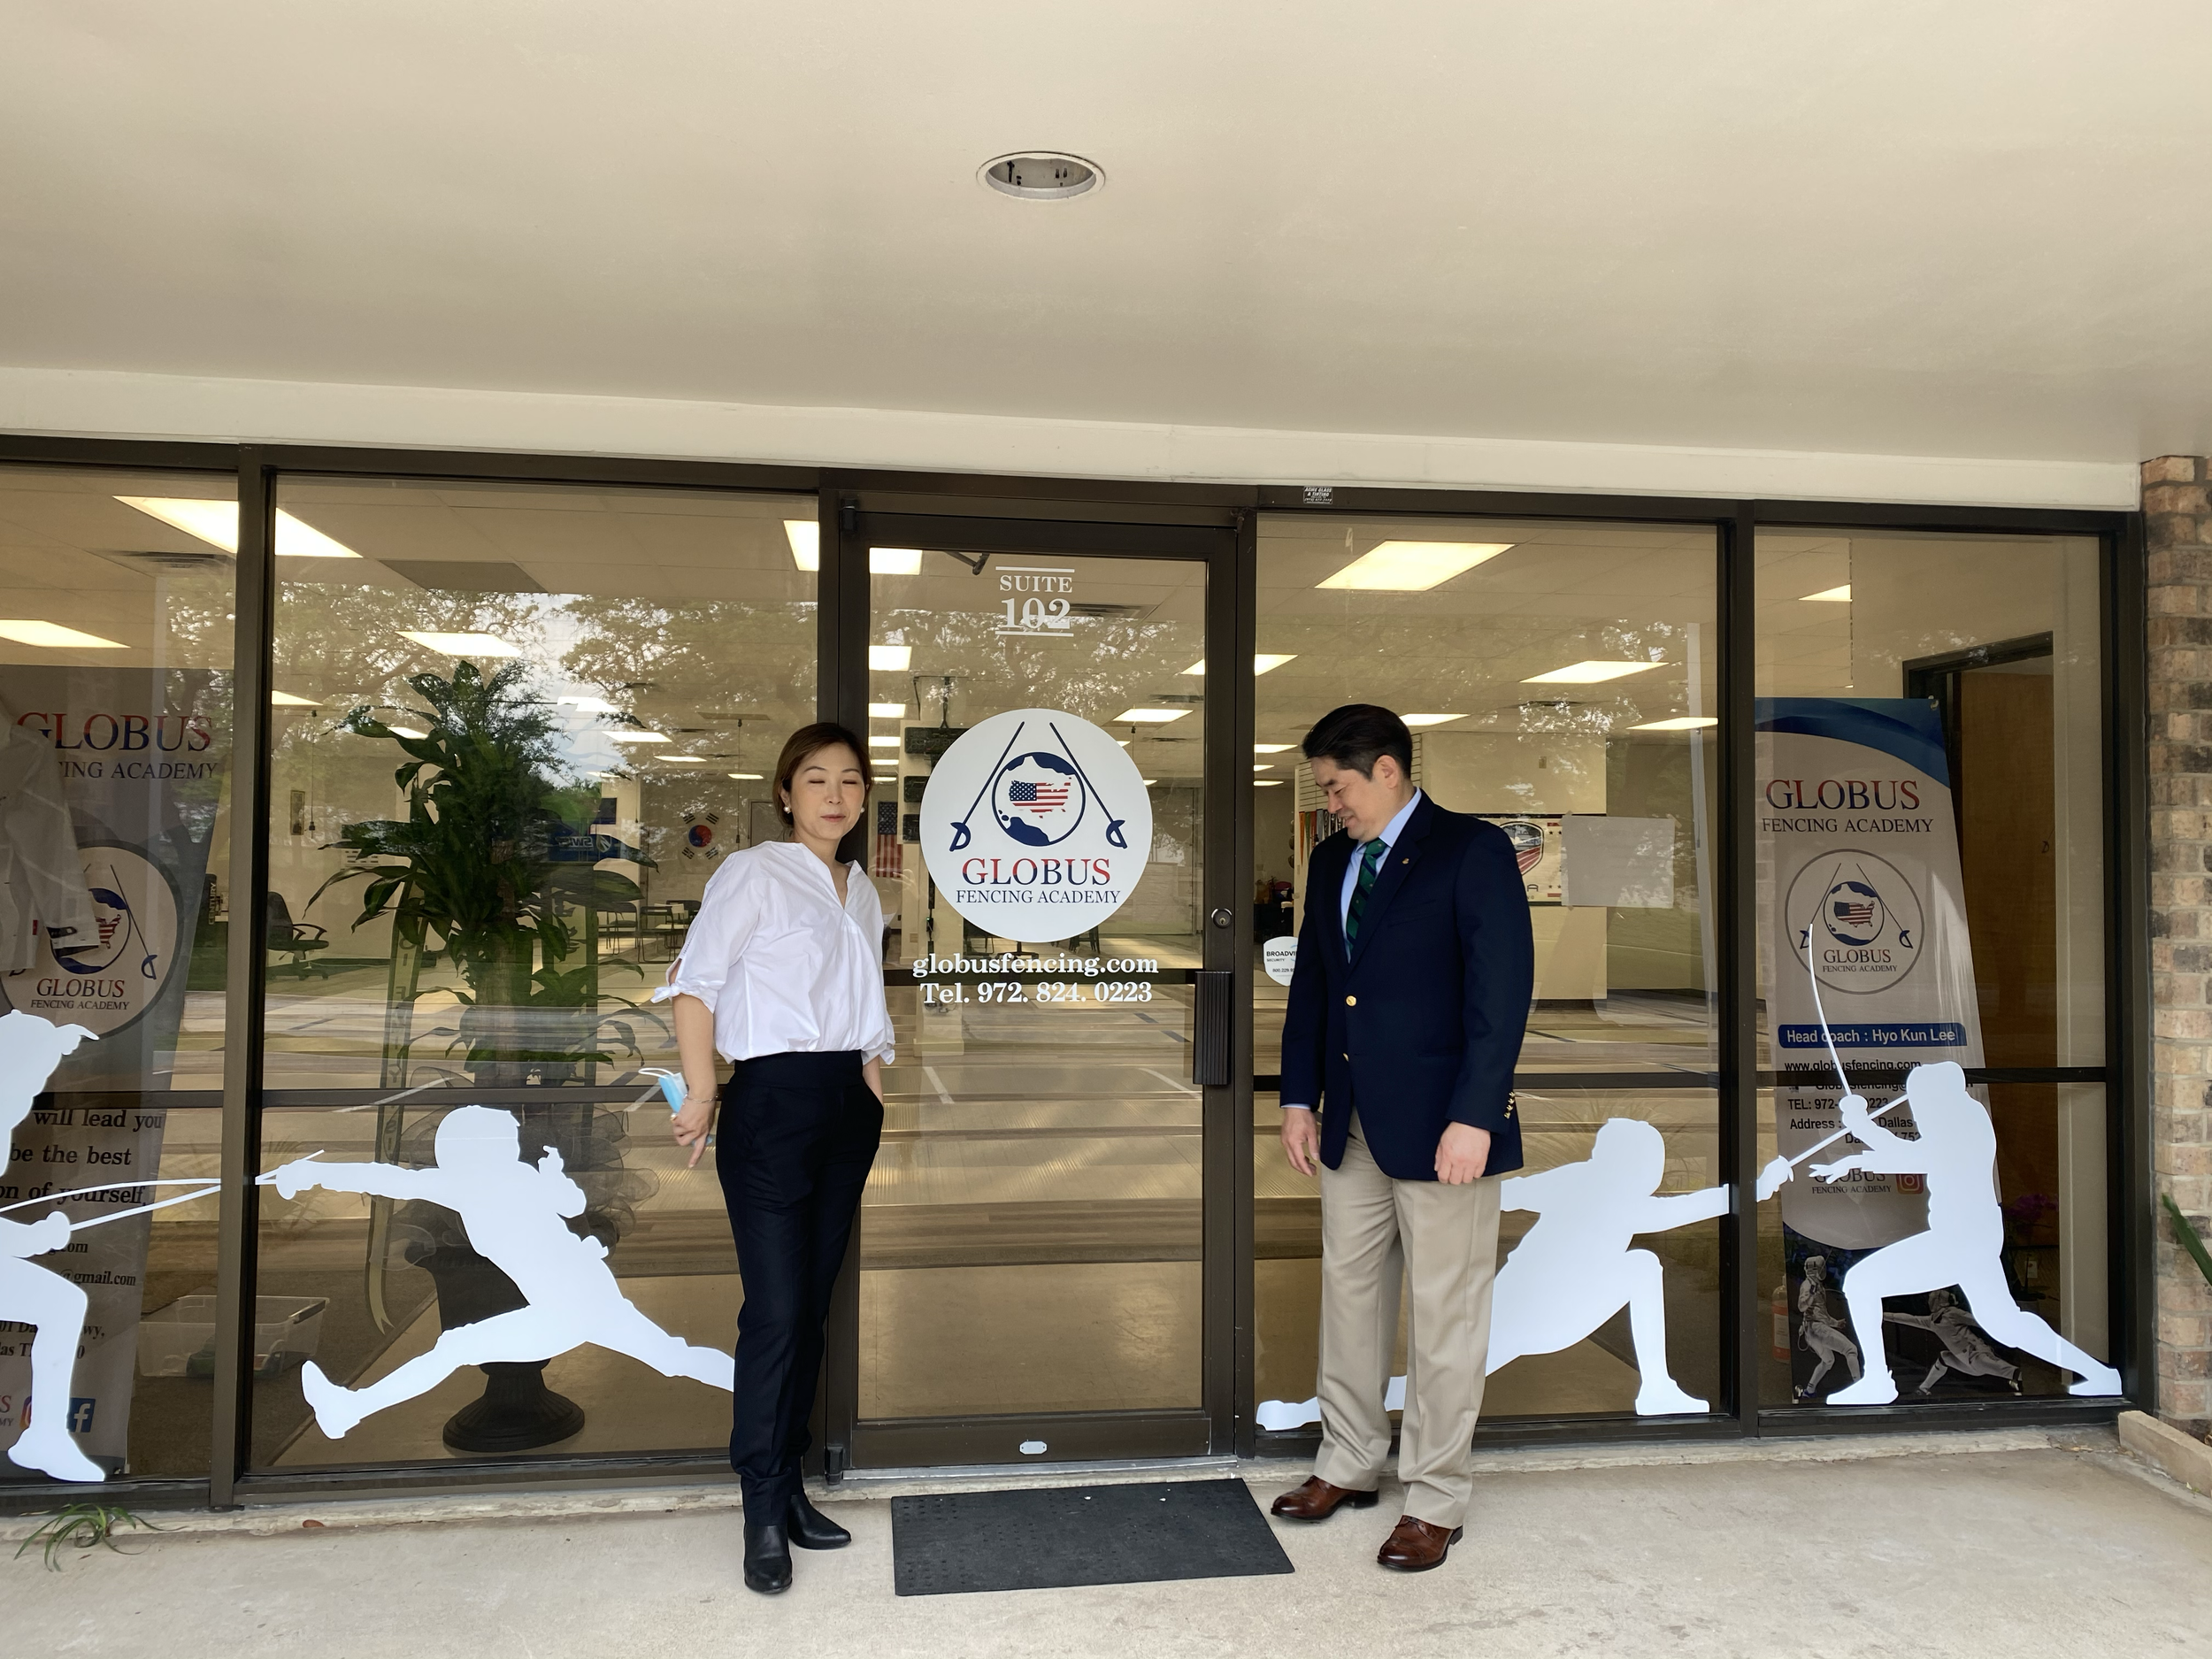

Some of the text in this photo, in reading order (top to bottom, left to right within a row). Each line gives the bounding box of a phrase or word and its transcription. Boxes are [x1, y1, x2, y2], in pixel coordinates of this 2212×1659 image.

[999, 574, 1073, 593] SUITE
[1000, 597, 1071, 629] 102
[111, 761, 219, 780] ACADEMY
[1766, 779, 1921, 810] GLOBUS
[1762, 818, 1935, 833] FENCING ACADEMY
[962, 857, 1110, 886] GLOBUS
[956, 889, 1121, 903] FENCING ACADEMY
[912, 953, 1159, 978] globusfencing.com
[1823, 949, 1892, 964] GLOBUS
[37, 977, 126, 998] GLOBUS
[919, 981, 1153, 1003] Tel. 972. 824. 0223
[30, 999, 130, 1010] FENCING ACADEMY
[1786, 1029, 1818, 1043] Head
[1871, 1028, 1896, 1044] Hyo
[1900, 1028, 1927, 1042] Kun
[1930, 1029, 1955, 1041] Lee
[1787, 1097, 1888, 1110] TEL: 972-223
[34, 1108, 163, 1133] will lead you
[1789, 1118, 1835, 1130] Address
[1878, 1116, 1914, 1129] Dallas
[10, 1143, 132, 1166] be the best
[28, 1181, 53, 1201] of
[1811, 1185, 1892, 1194] FENCING ACADEMY
